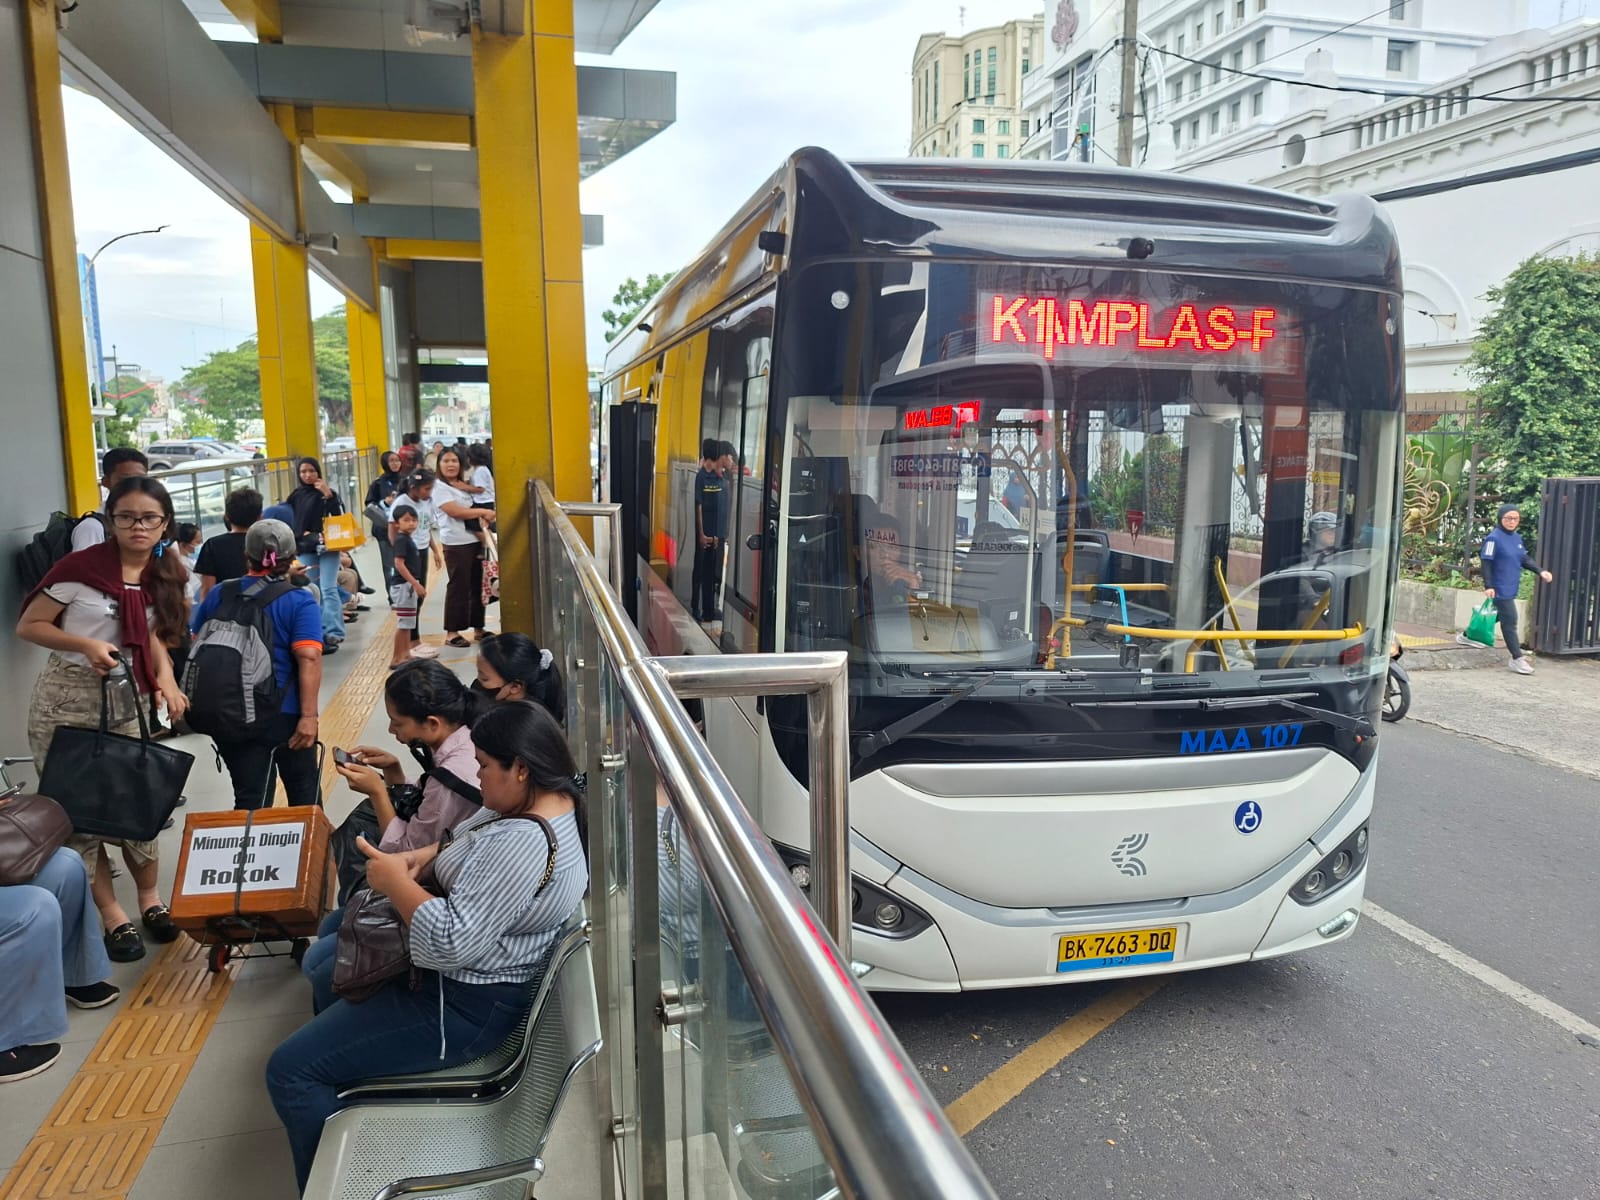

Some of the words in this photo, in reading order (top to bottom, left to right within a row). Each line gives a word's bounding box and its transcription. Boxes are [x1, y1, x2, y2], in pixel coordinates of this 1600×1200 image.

[1180, 727, 1251, 754] MAA
[1261, 723, 1303, 749] 107
[259, 830, 300, 848] Dingin
[232, 852, 256, 865] dn
[200, 865, 280, 886] Rokok
